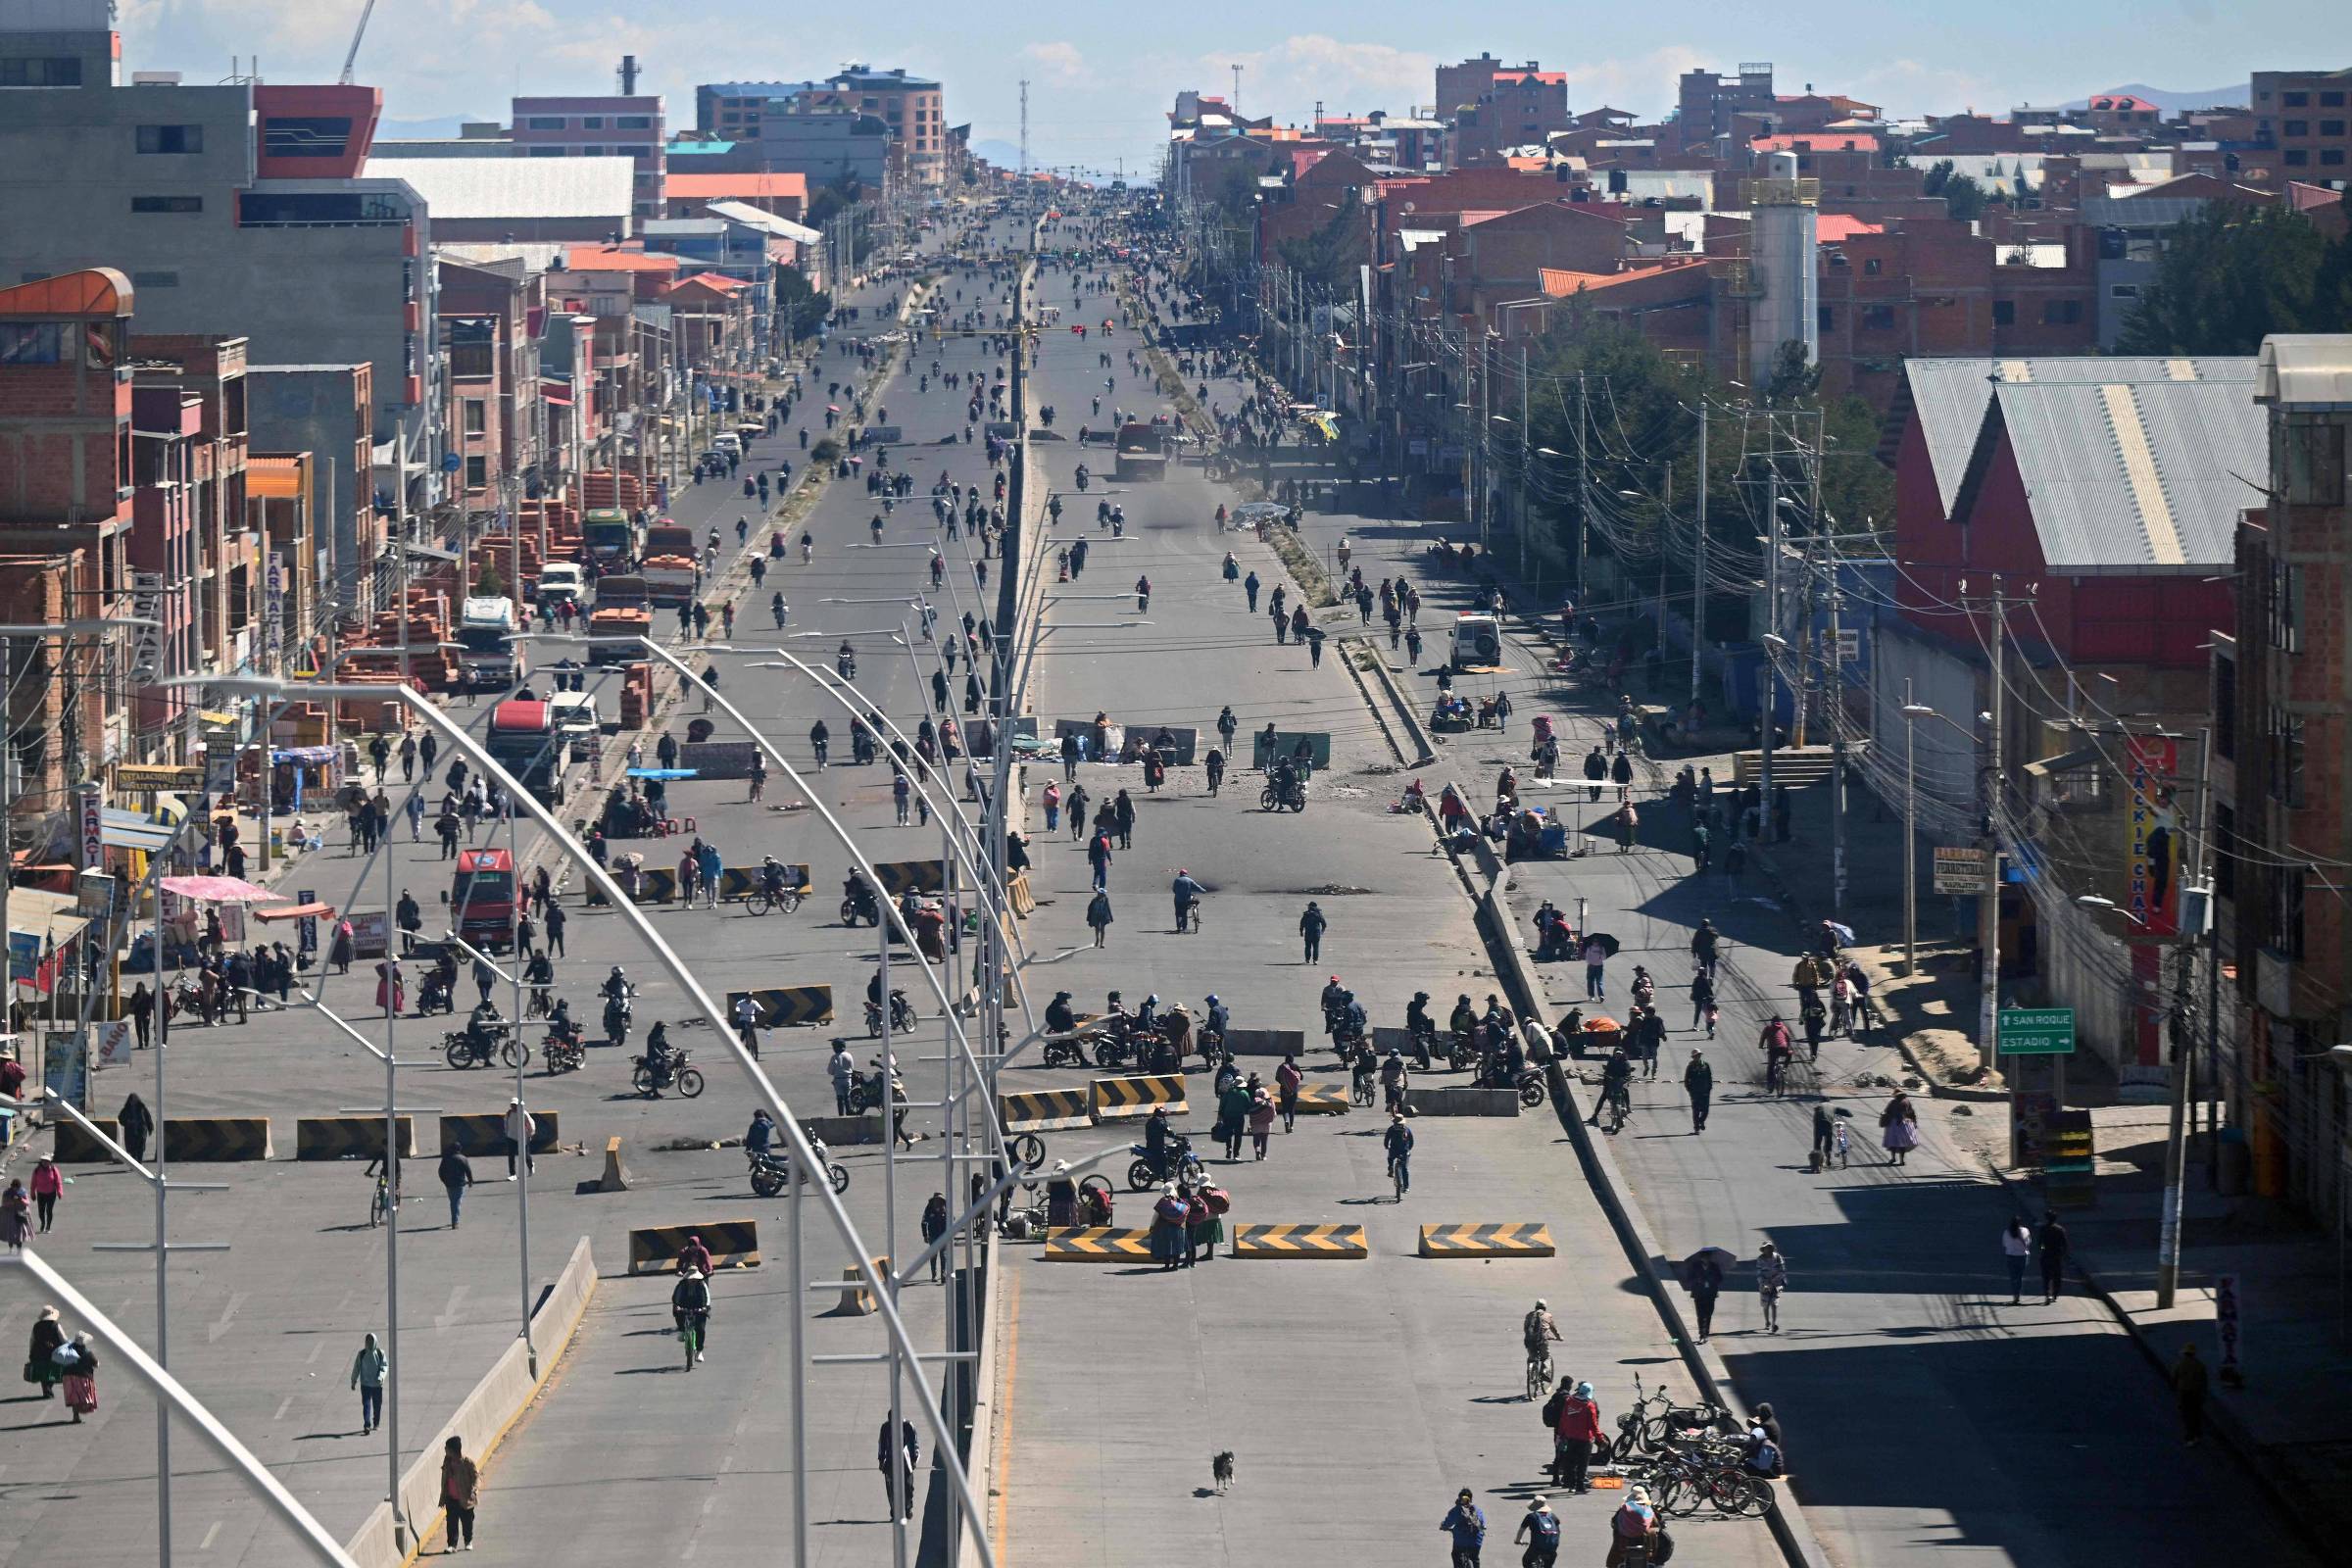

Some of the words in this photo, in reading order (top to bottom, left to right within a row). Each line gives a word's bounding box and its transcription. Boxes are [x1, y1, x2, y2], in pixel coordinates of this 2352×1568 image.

[268, 553, 280, 649] FARMACIA
[303, 789, 336, 801] BARRAC
[2132, 760, 2146, 856] JACKIE
[85, 799, 100, 867] FARMACI
[2012, 1015, 2034, 1025] SAN
[2035, 1014, 2071, 1025] ROQUE
[2001, 1037, 2050, 1047] ESTADIO
